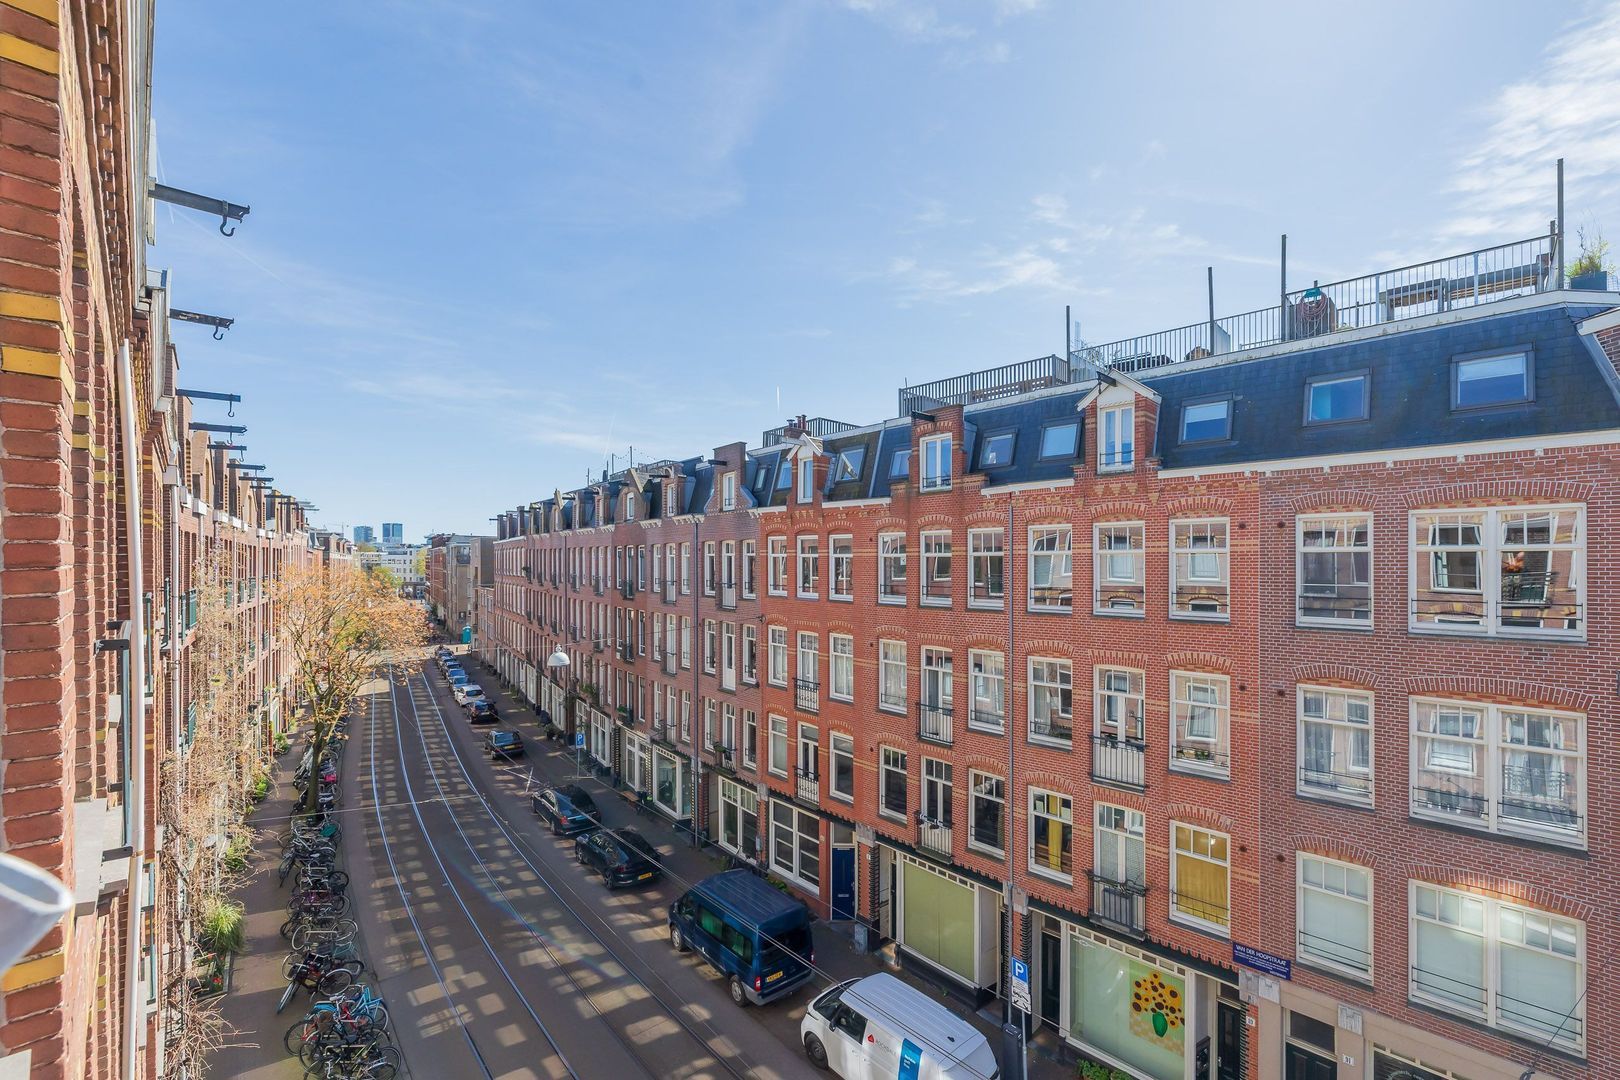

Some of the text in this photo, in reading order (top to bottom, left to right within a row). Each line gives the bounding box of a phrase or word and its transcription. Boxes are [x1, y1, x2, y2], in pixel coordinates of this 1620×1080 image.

[1235, 944, 1287, 967] VAN DER HOOPSTRAAT
[1015, 961, 1024, 977] P
